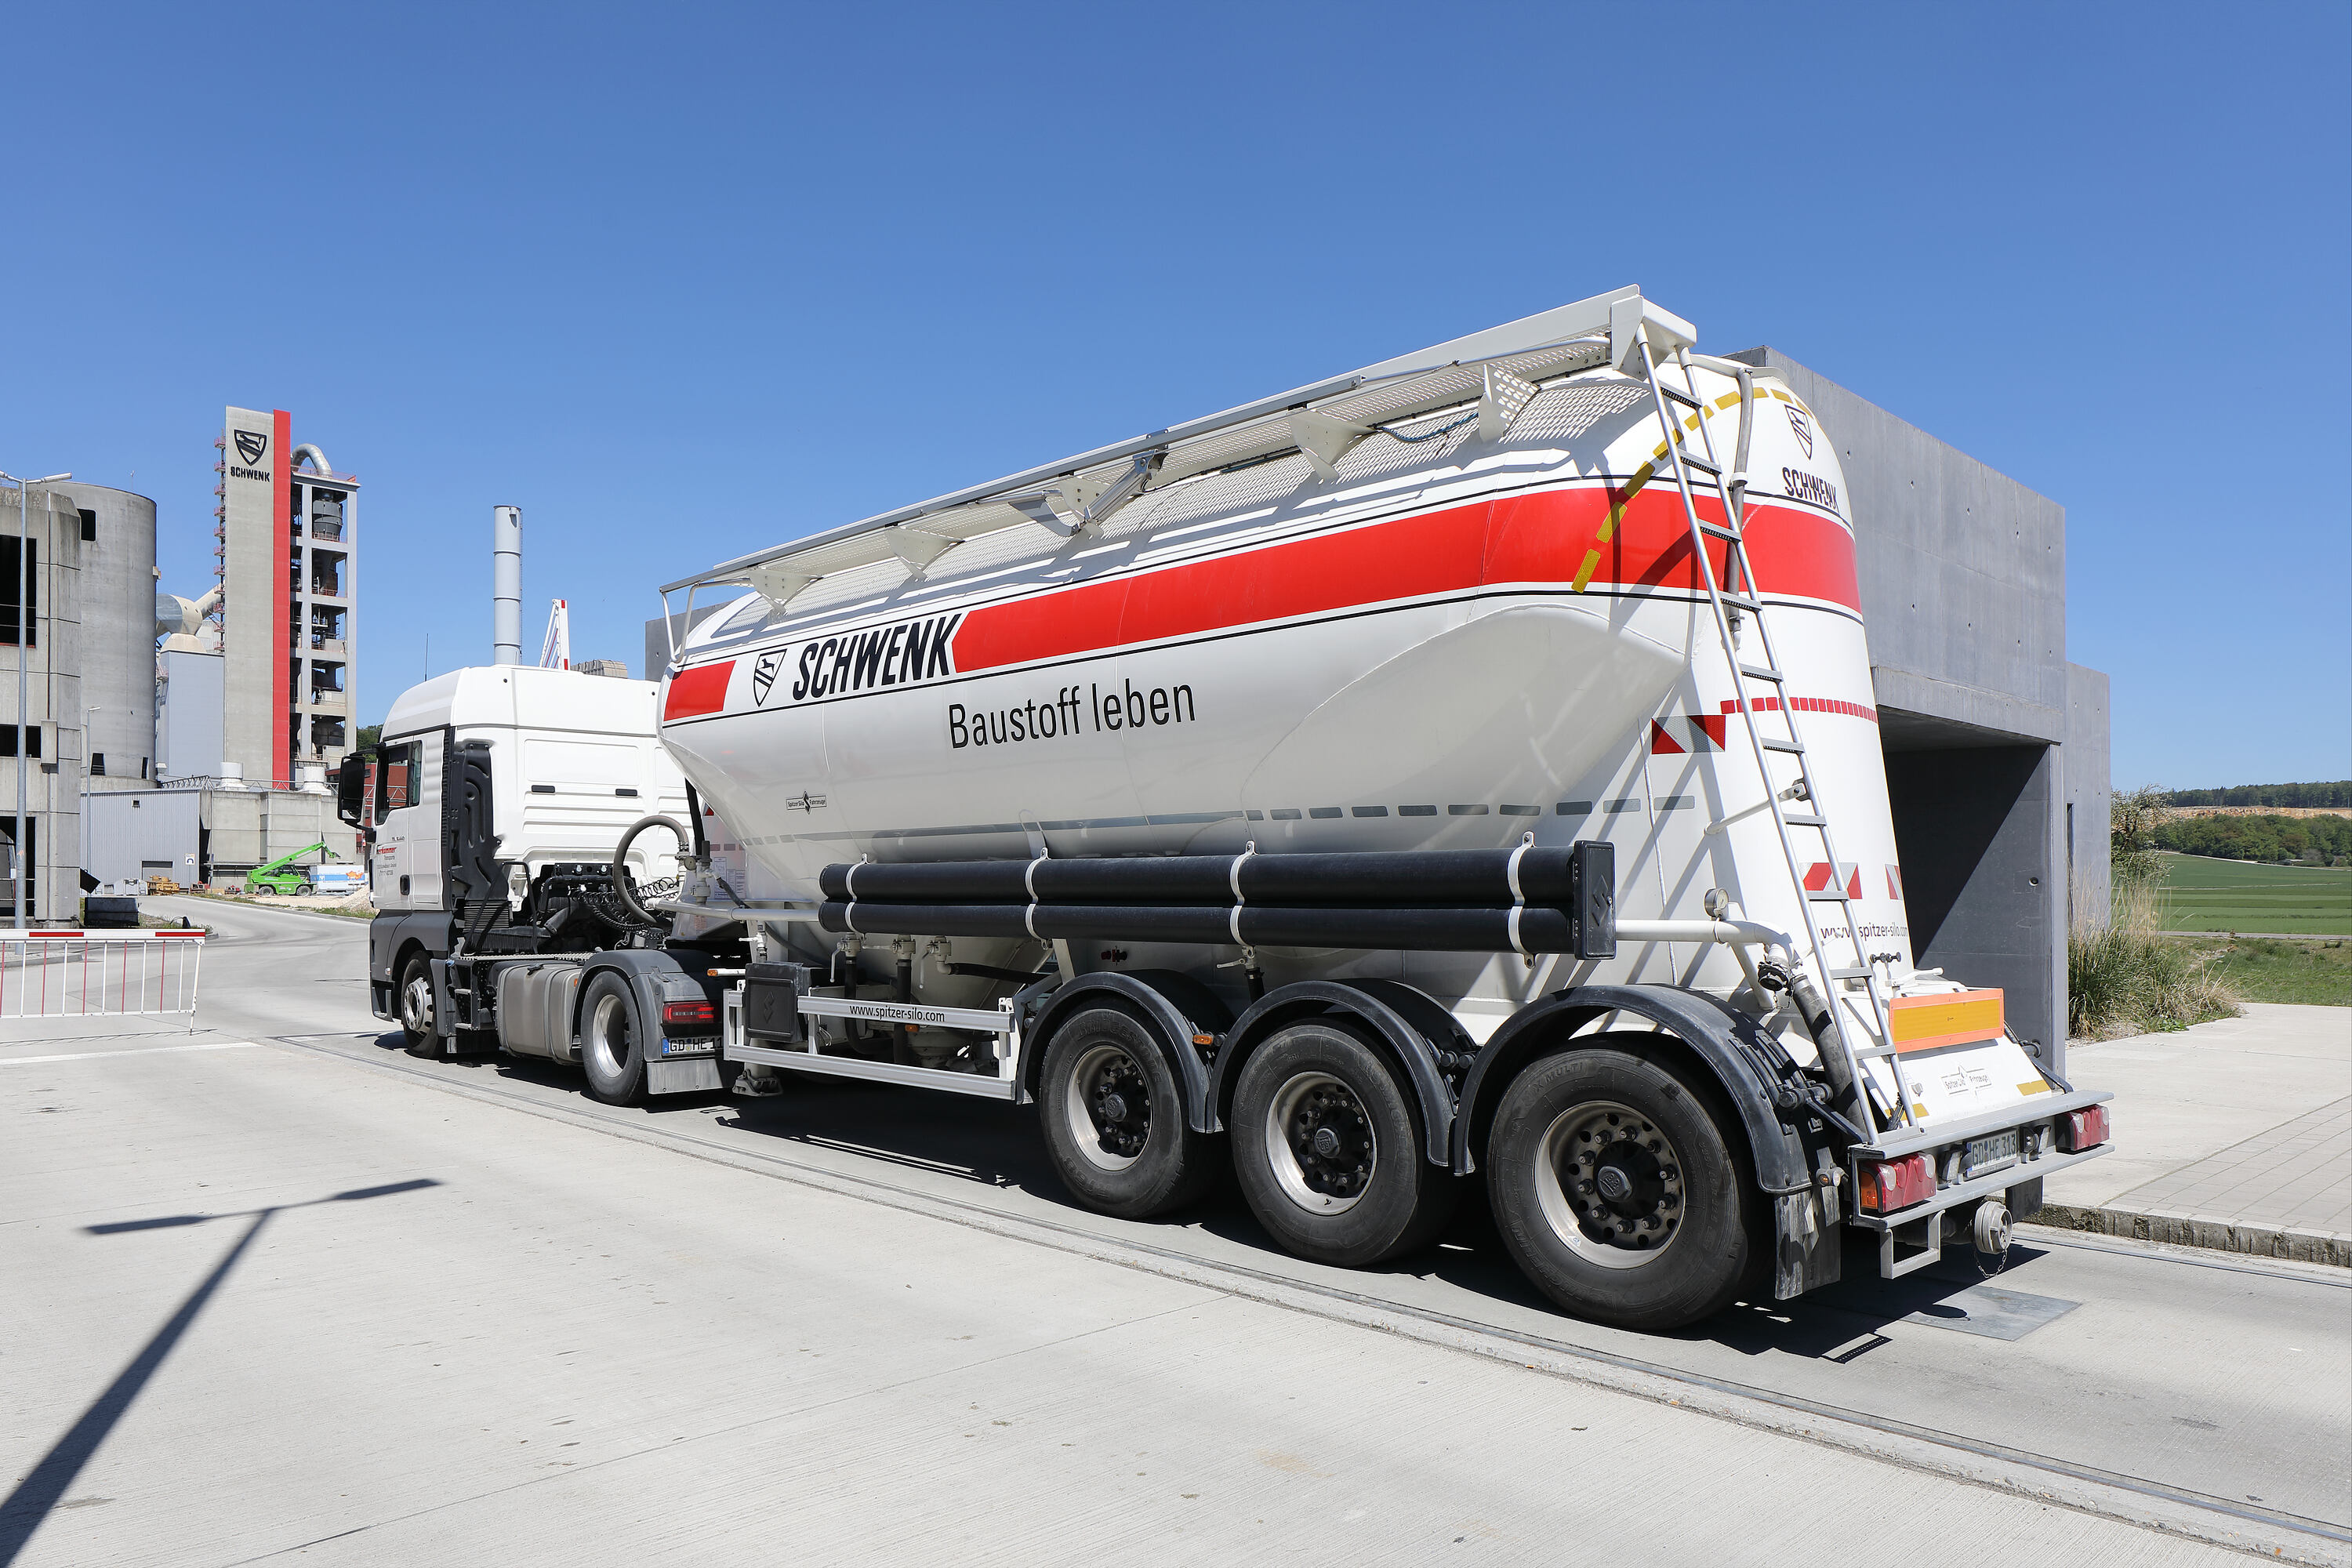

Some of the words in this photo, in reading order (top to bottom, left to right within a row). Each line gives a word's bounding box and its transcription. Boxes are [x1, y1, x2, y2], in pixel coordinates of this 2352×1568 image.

[230, 466, 270, 483] SCHWENK
[1781, 466, 1840, 514] SCHWENK
[792, 612, 963, 701] SCHWENK
[949, 684, 1081, 750] Baustoff
[1091, 677, 1196, 732] leben
[849, 1004, 946, 1022] www.spitzer-silo.com
[670, 1039, 685, 1052] GD
[692, 1037, 707, 1051] HE
[1544, 1062, 1583, 1084] MULTI
[1972, 1142, 1984, 1166] GD
[1988, 1138, 2000, 1162] HE
[2001, 1134, 2016, 1158] 313
